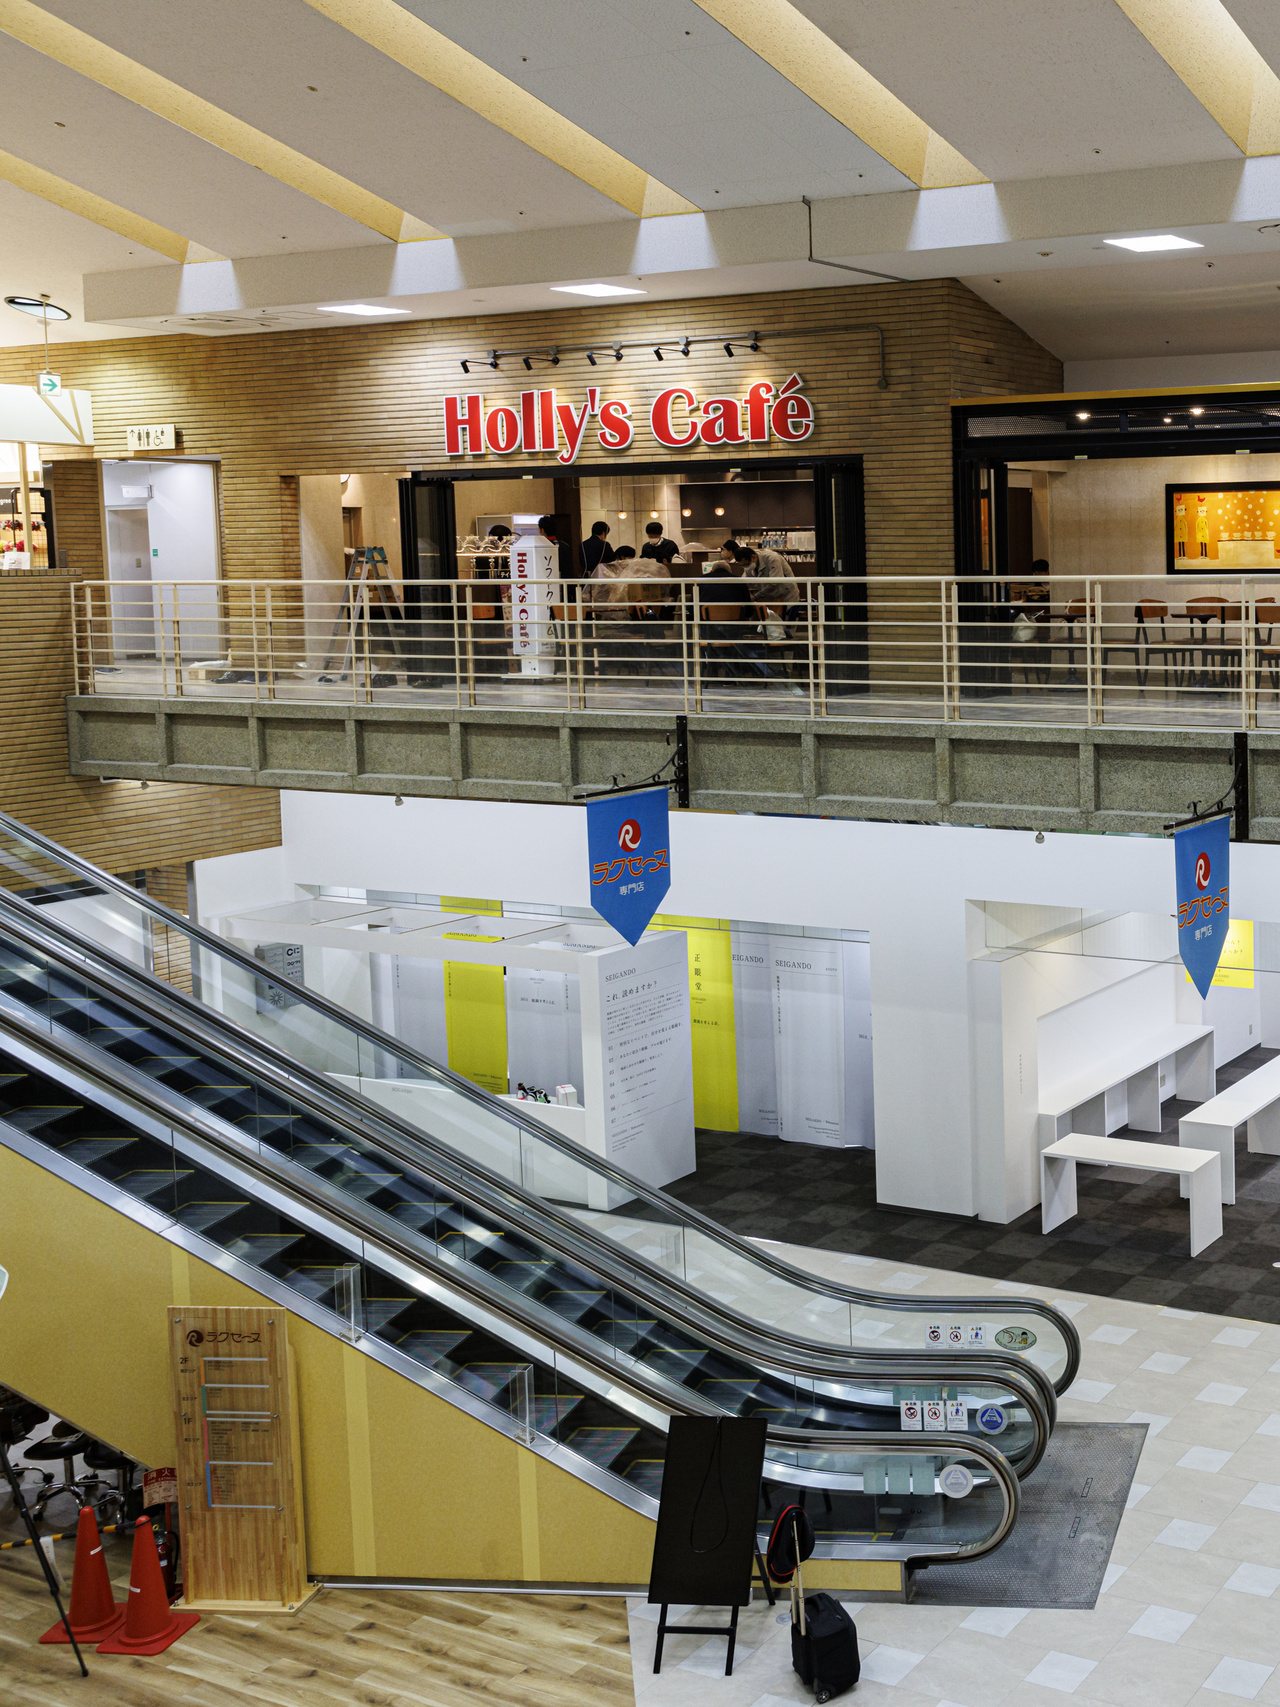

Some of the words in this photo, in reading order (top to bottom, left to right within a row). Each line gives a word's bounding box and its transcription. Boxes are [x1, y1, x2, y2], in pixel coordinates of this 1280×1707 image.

[443, 387, 635, 465] Holly's
[650, 372, 815, 448] Café
[516, 552, 529, 604] Holy's
[544, 555, 555, 636] ソフクム
[592, 848, 669, 885] ラクセーヌ
[619, 881, 645, 896] 専門店
[1178, 886, 1229, 930] ラクセーヌ
[1194, 924, 1213, 941] 専門店
[732, 954, 764, 964] EIGANDO
[775, 959, 812, 970] SEIGANDO
[605, 967, 637, 983] SEIGANDO
[206, 1331, 262, 1344] ラクセーヌ
[183, 1417, 193, 1425] 1F
[148, 1468, 177, 1480] 消火
